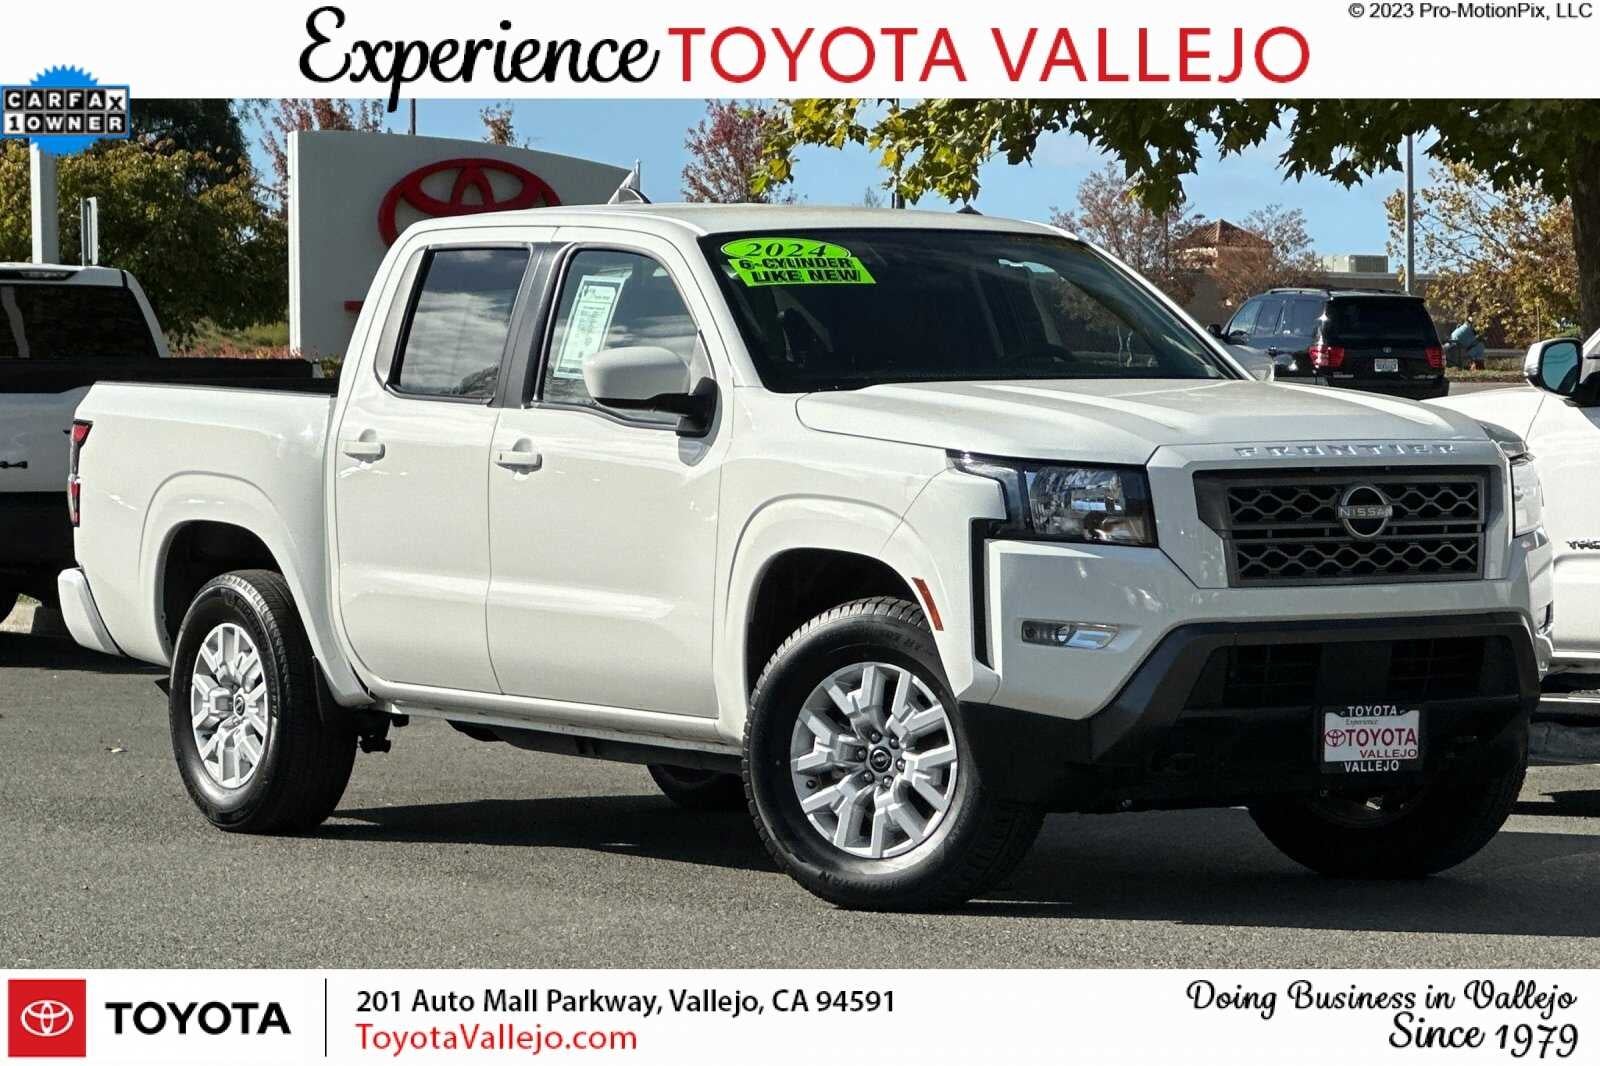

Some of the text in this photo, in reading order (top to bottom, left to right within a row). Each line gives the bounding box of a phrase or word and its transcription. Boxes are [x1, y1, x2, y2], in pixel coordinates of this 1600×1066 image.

[745, 242, 828, 257] 2024
[738, 256, 853, 271] 6-CYLINDER
[750, 269, 859, 283] LIKE NEW
[1339, 506, 1392, 517] NISSAN
[1346, 705, 1398, 718] TOYOTA
[1345, 728, 1418, 747] TOYOTA
[1359, 748, 1418, 759] VALLEJO
[1343, 760, 1400, 773] VALLEJO
